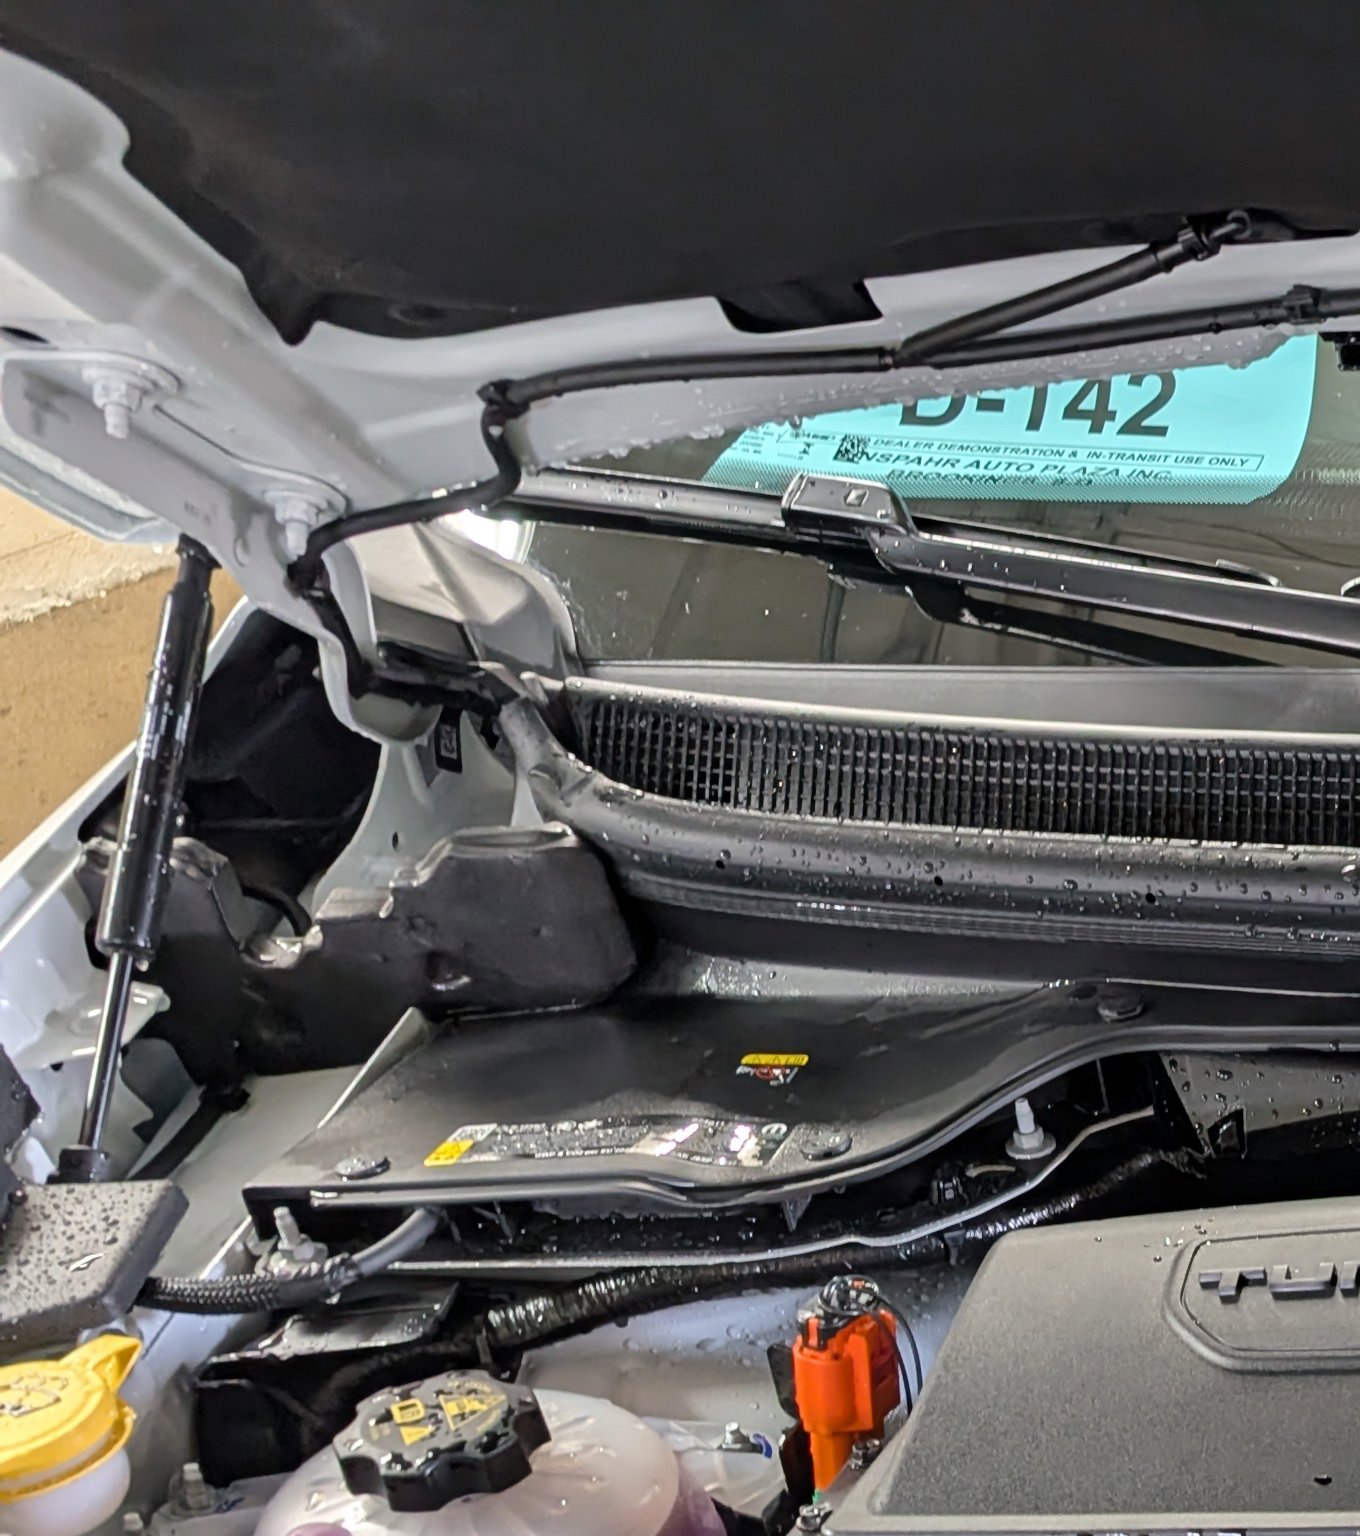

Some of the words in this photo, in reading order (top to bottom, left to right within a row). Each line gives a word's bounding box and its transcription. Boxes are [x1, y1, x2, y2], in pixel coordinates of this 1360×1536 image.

[857, 451, 956, 469] NSPAHR
[963, 457, 1034, 473] AUTO
[1040, 463, 1120, 477] PLAZA
[874, 439, 934, 450] DEALER
[937, 443, 1066, 459] DEMONSTRATION
[1068, 450, 1078, 458] &
[1087, 451, 1170, 463] IN-TRANSIT
[1174, 455, 1204, 464] USE
[1209, 457, 1249, 467] ONLY
